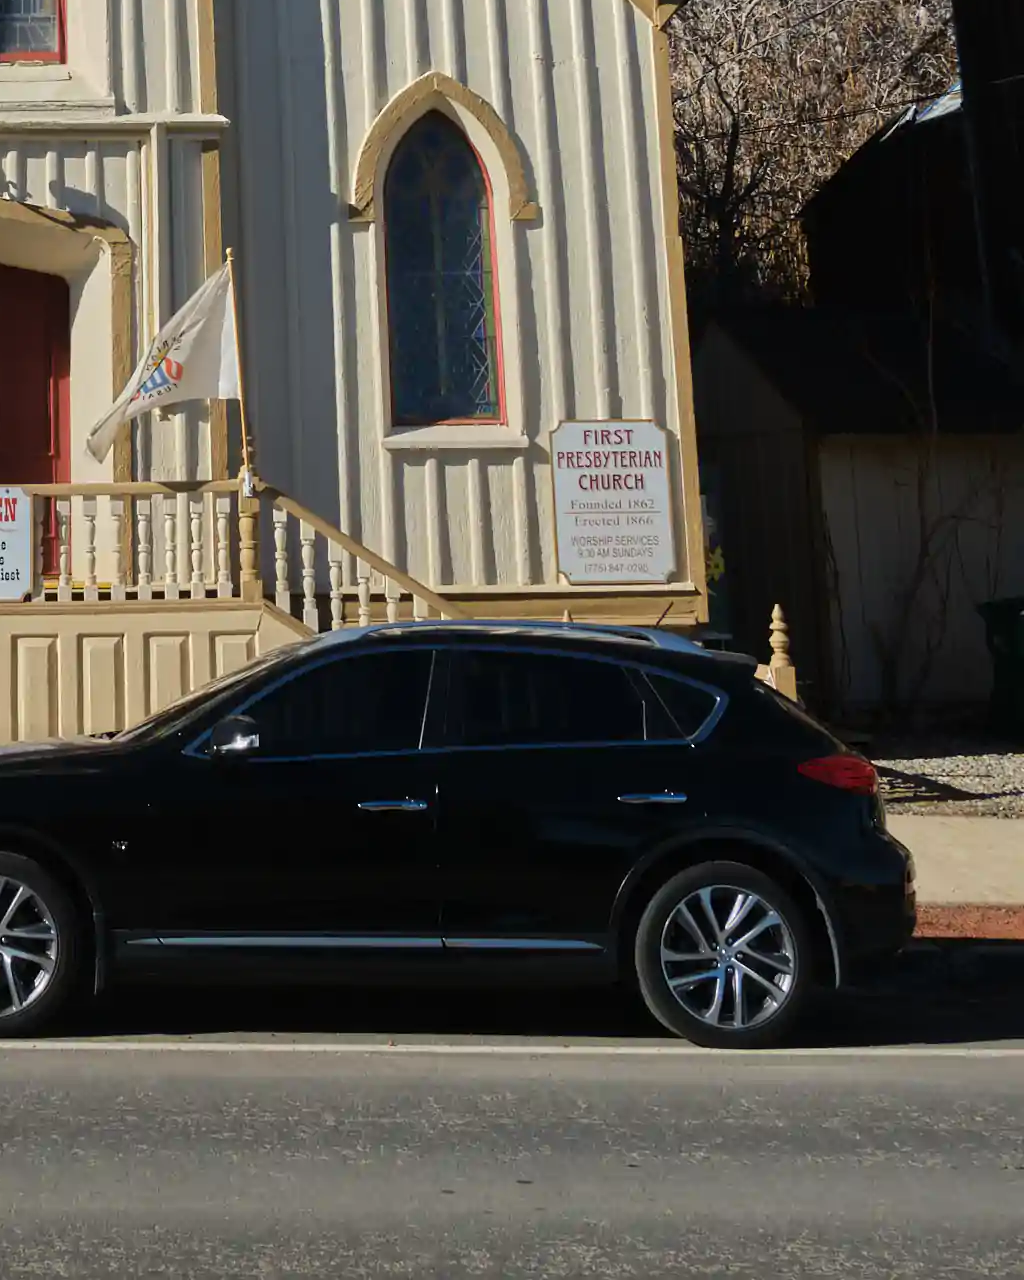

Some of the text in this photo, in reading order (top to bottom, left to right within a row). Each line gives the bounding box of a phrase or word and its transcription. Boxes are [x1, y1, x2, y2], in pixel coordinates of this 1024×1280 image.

[583, 429, 634, 445] FIRST
[557, 450, 662, 469] PRESBYTERIAN
[578, 473, 645, 491] CHURCH
[570, 498, 655, 510] Founded 1862
[574, 514, 654, 527] Erected 1866
[570, 535, 660, 547] WORSHIP SERVICES
[597, 547, 610, 558] AM
